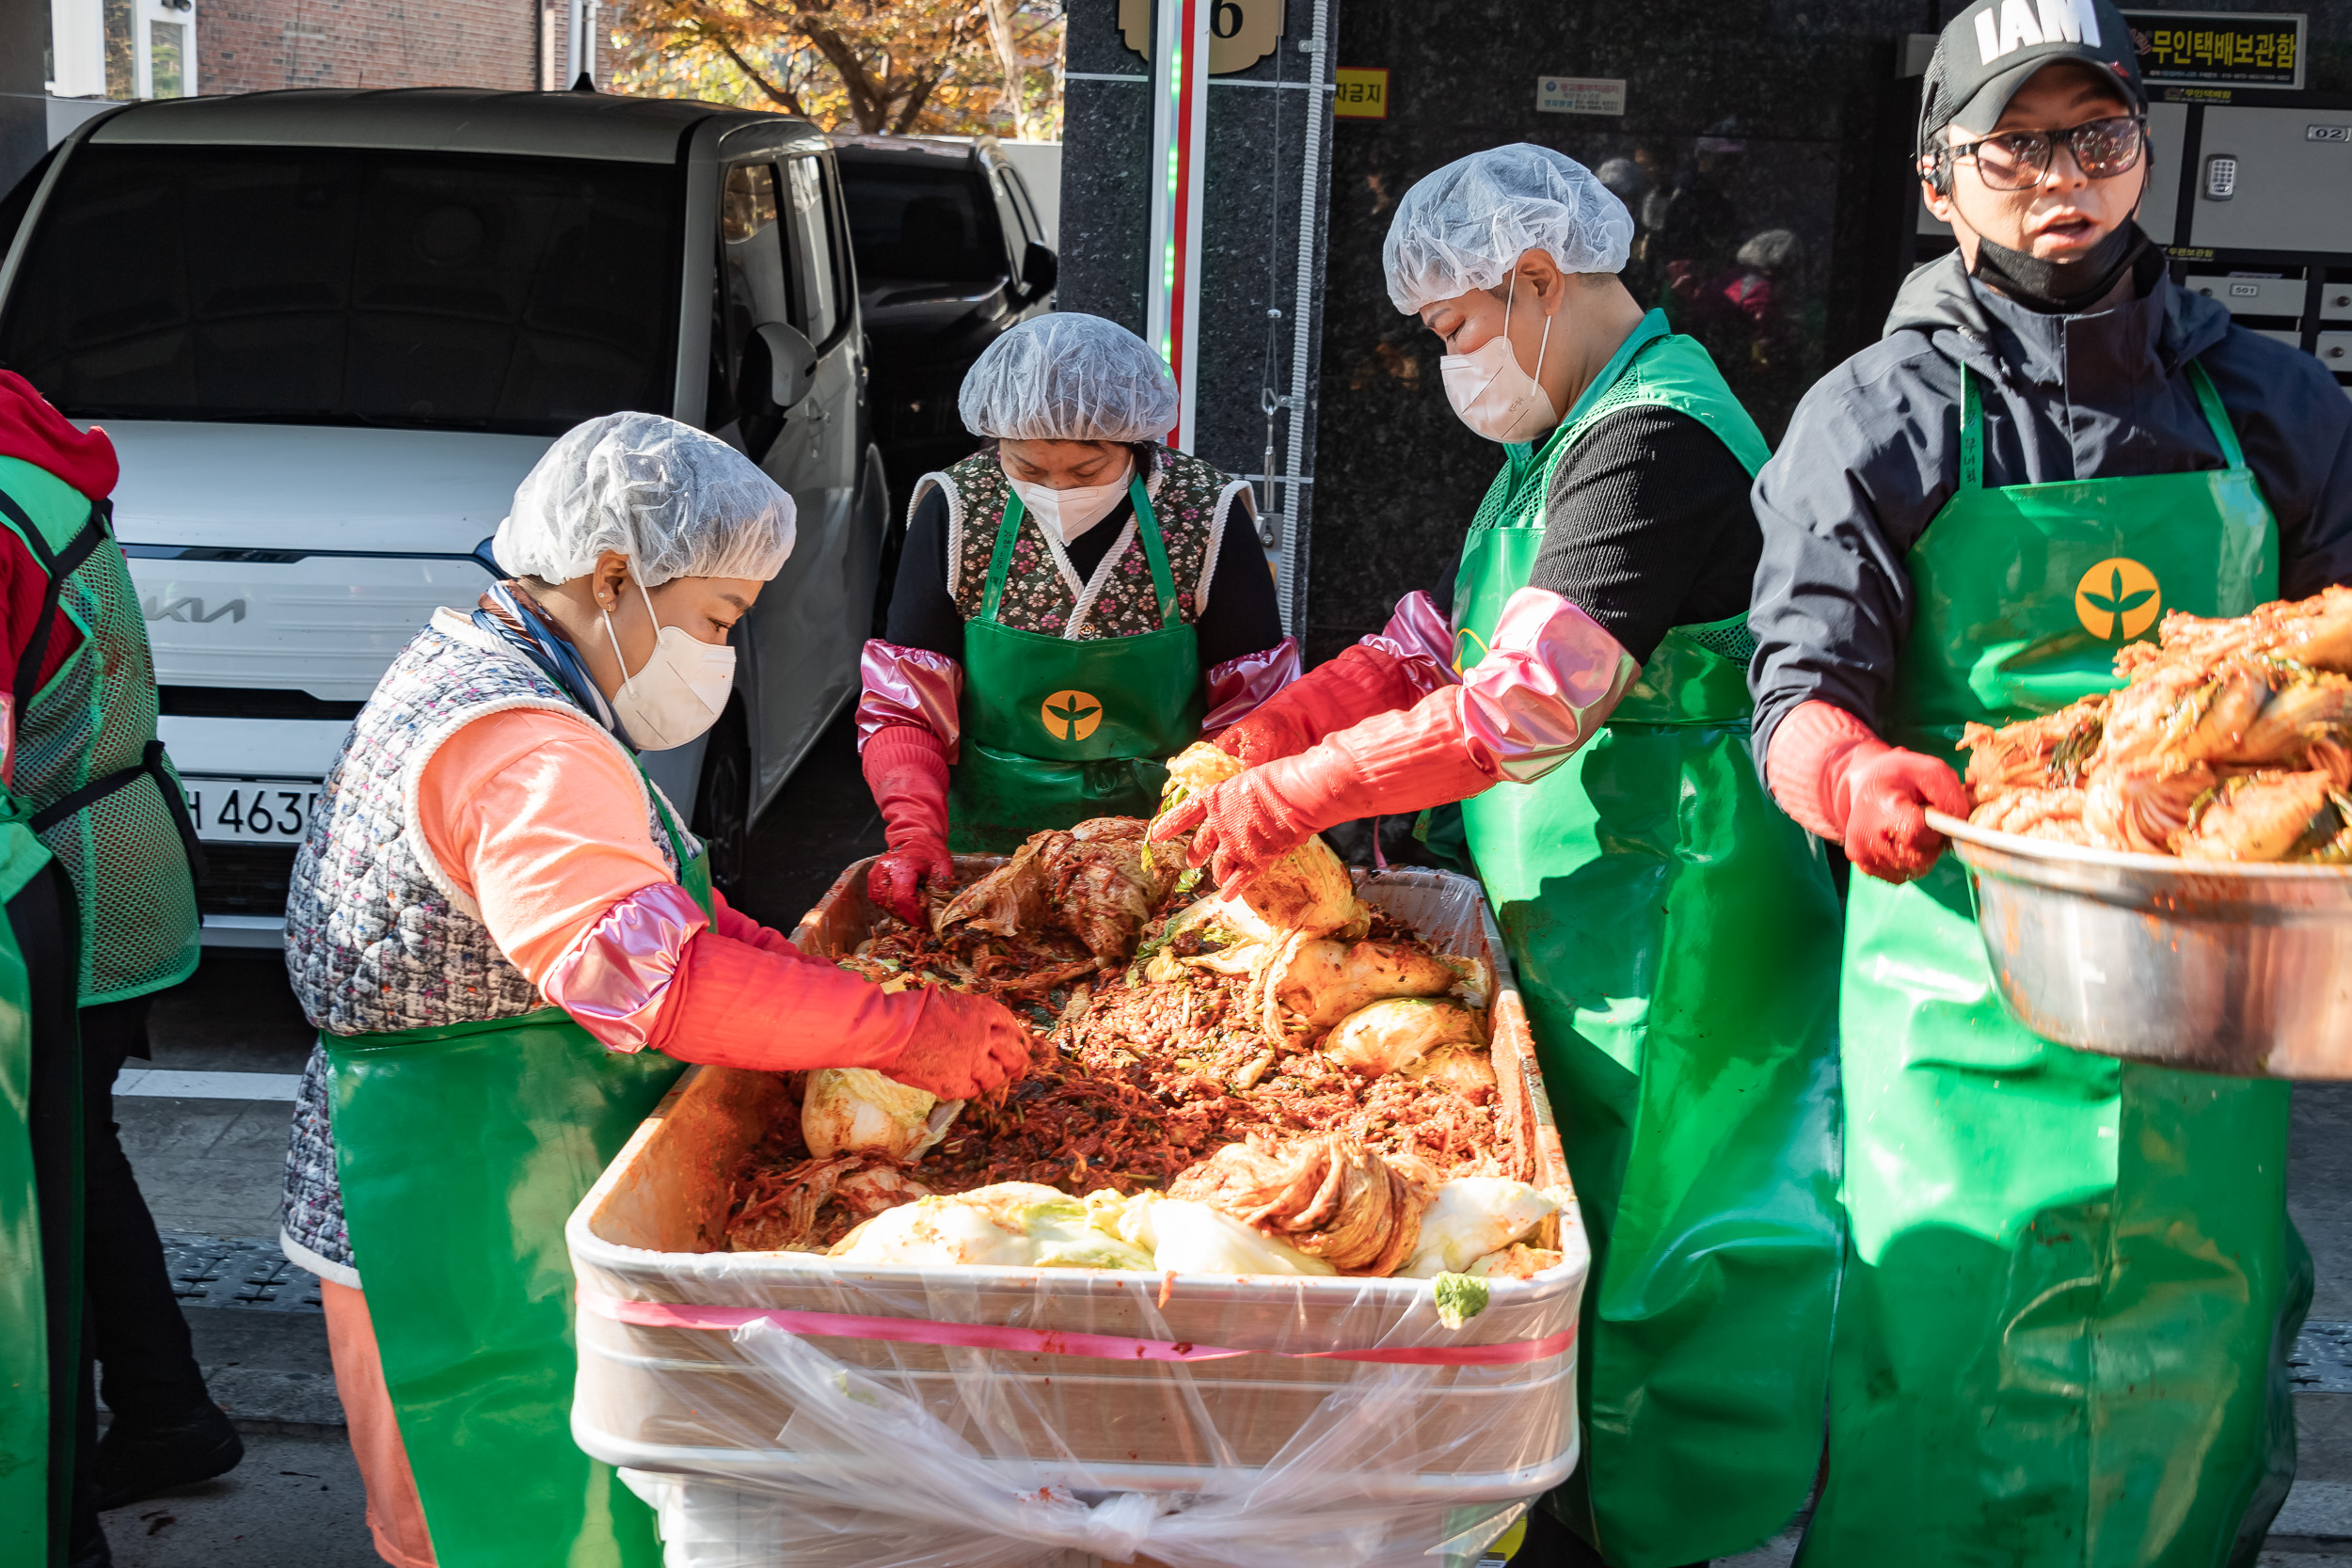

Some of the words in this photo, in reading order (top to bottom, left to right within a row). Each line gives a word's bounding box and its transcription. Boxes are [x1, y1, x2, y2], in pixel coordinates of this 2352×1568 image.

[1974, 0, 2102, 66] IAM
[2152, 30, 2296, 69] 무인택배보관함
[2315, 128, 2343, 138] 02
[217, 790, 316, 835] 463
